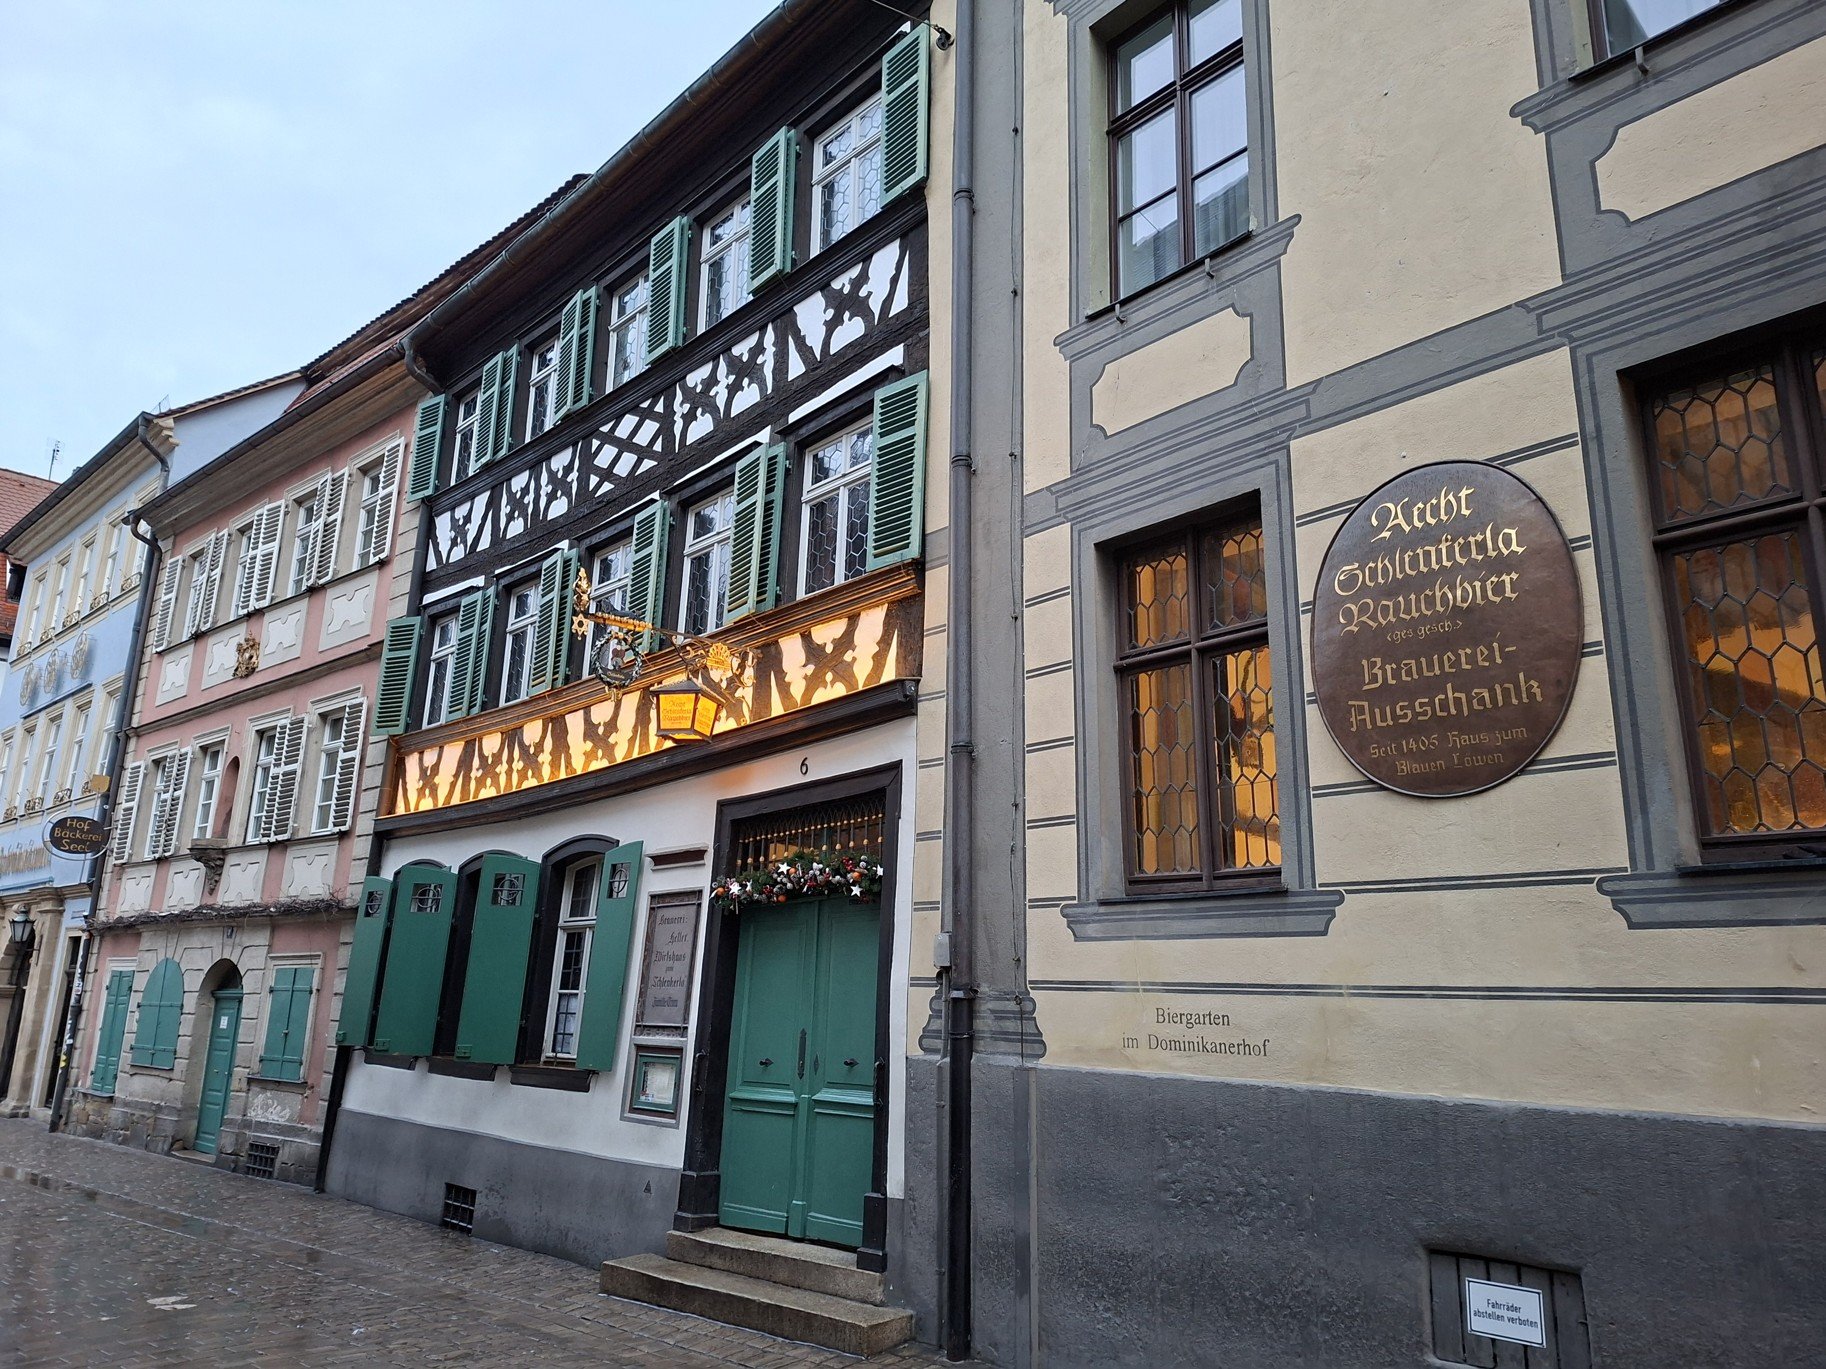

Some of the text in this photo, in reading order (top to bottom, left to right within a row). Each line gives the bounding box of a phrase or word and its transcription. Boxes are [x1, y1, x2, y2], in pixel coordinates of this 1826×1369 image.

[1371, 485, 1475, 542] Aecht
[1334, 522, 1527, 596] Schlenkerla
[1339, 571, 1520, 637] Rauchbier
[1361, 632, 1518, 691] Brauerei-
[1348, 672, 1543, 732] Ausschank
[1370, 742, 1398, 758] Seit
[1402, 734, 1439, 754] 1405
[1448, 732, 1489, 749] Haus
[800, 757, 808, 775] 6
[1396, 753, 1504, 775] Blauen Löwen
[54, 827, 102, 841] Bäckerei
[66, 819, 92, 831] Hof
[1156, 1007, 1230, 1029] Biergarten
[1122, 1032, 1270, 1056] im Dominikanerhof
[1487, 1299, 1521, 1313] Fahrräder
[1473, 1309, 1539, 1328] abstellen verboten
